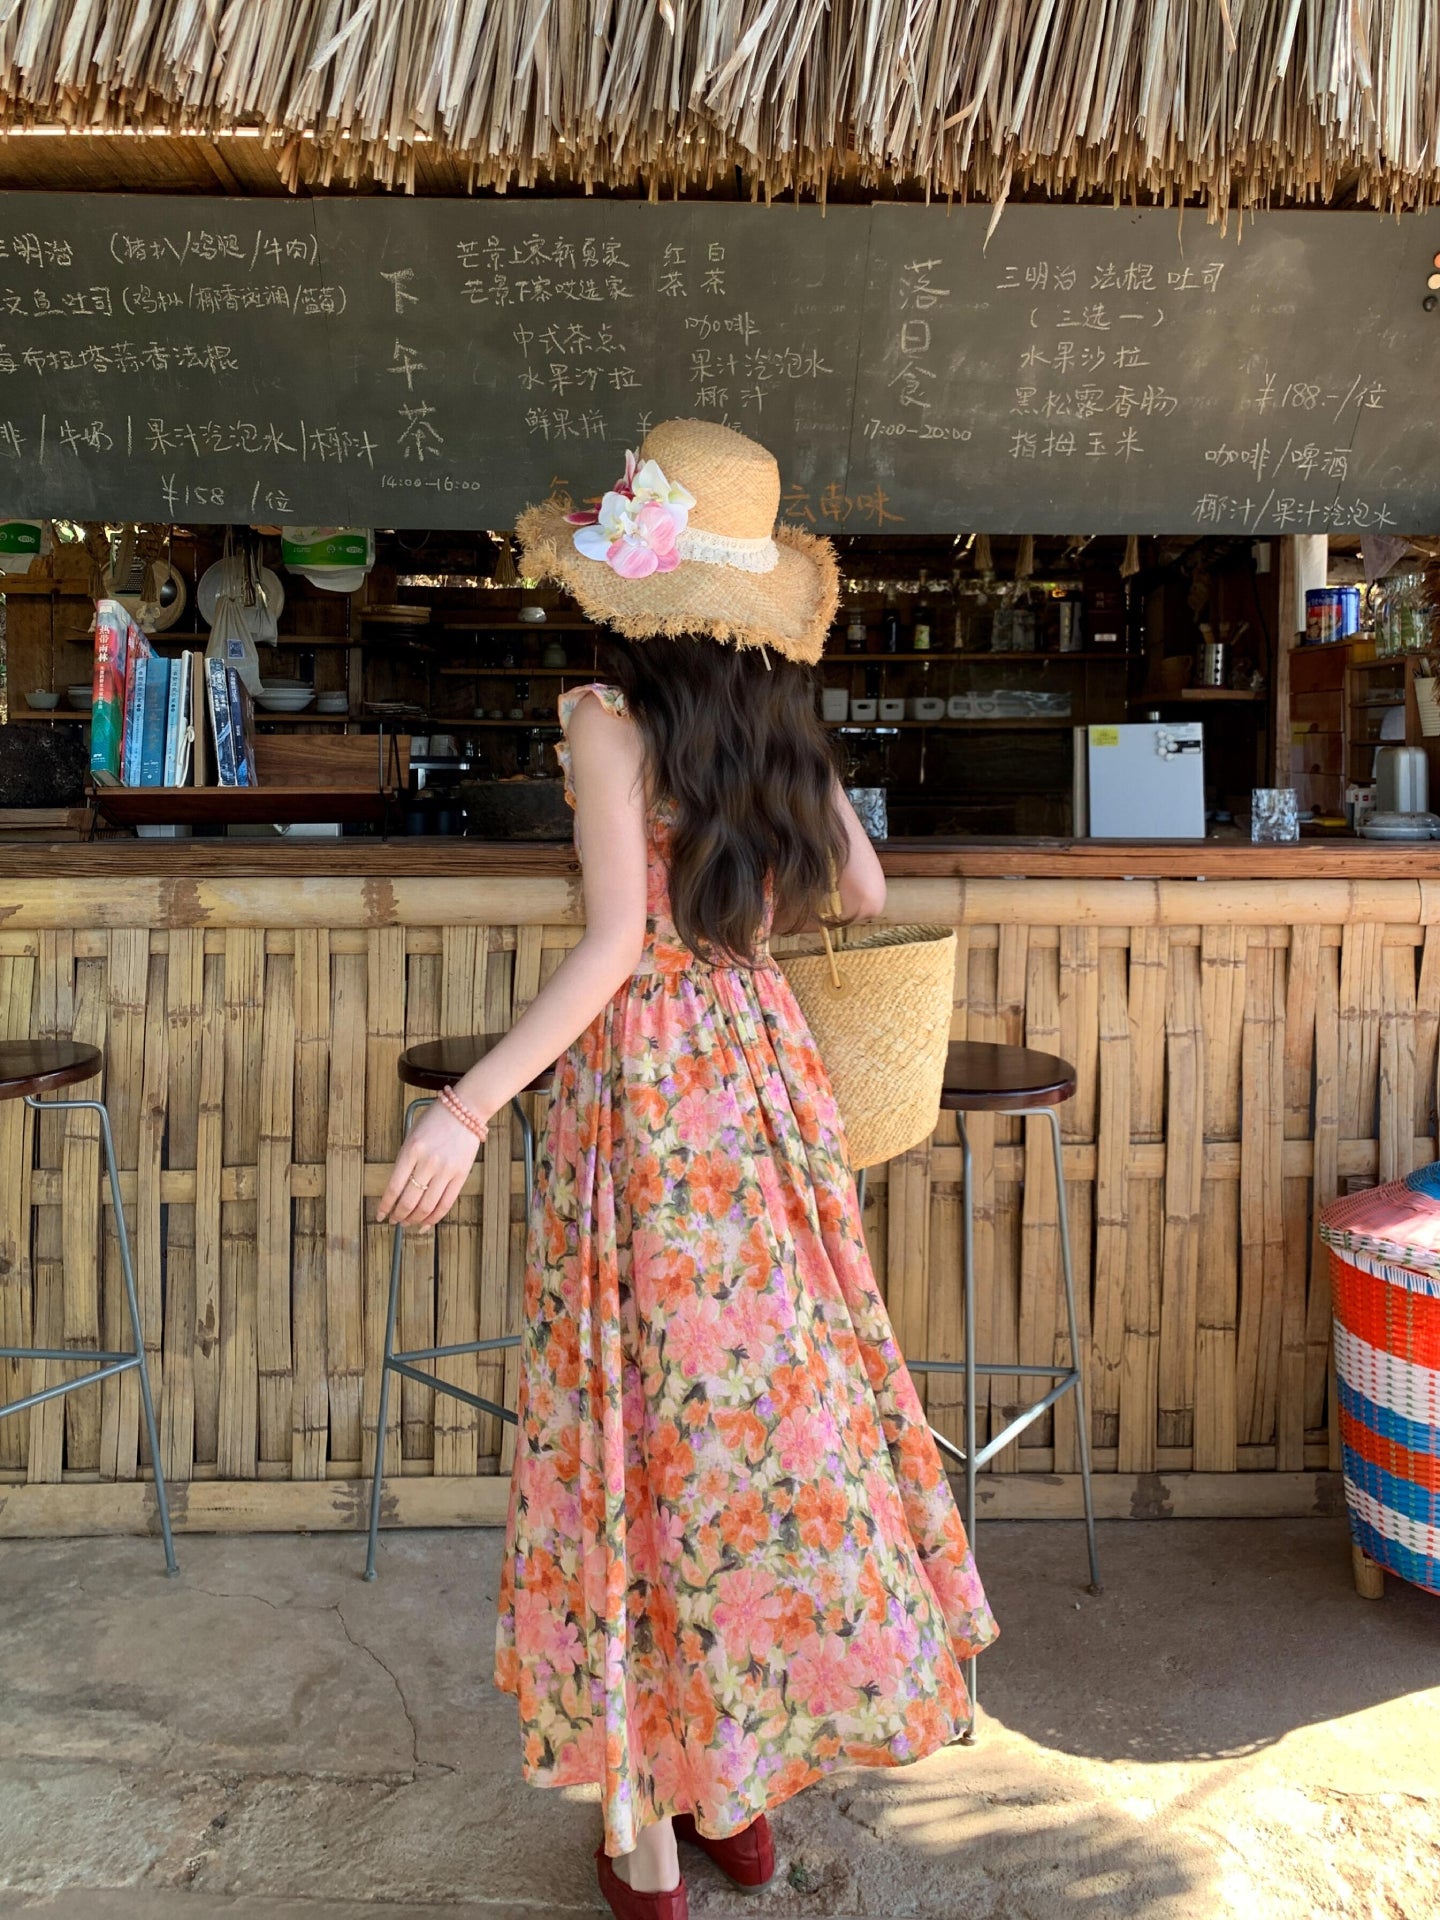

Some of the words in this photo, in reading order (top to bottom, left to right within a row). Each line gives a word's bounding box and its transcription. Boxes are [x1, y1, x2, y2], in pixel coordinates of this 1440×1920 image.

[996, 261, 1077, 292] 三明治
[1090, 262, 1157, 292] 法棍
[1167, 262, 1226, 292] 吐司
[513, 322, 626, 357] 中式茶点
[684, 311, 762, 347] 咖啡
[379, 267, 444, 462] 下午茶
[1020, 341, 1151, 374] 水果沙拉
[518, 363, 643, 396] 水果沙拉
[694, 385, 768, 412] 椰汁
[1009, 383, 1178, 419] 黑松露香肠
[523, 406, 609, 440] 鲜果拼
